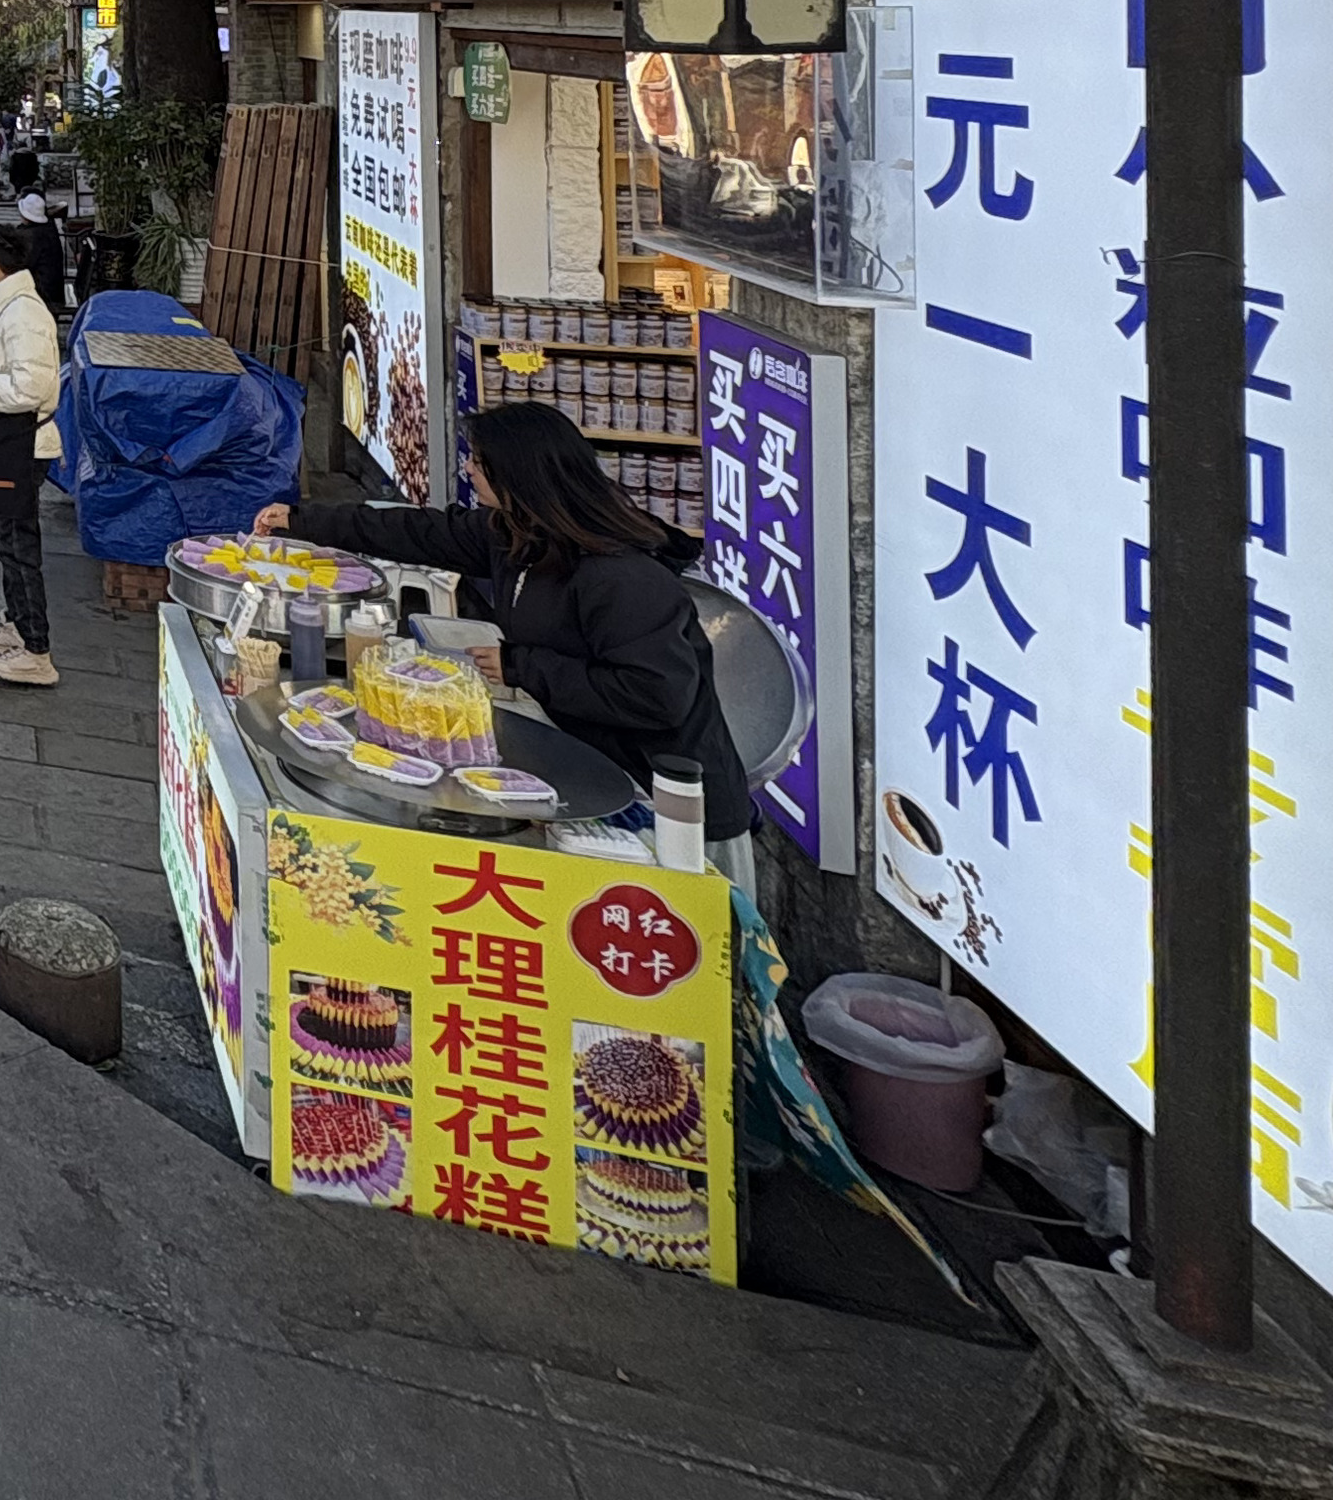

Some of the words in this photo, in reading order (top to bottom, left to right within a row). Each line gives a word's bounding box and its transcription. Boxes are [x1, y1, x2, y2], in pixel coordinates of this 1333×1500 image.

[349, 29, 404, 86] 现磨咖啡
[350, 87, 406, 155] 免费试喝
[351, 149, 407, 223] 全国包邮
[708, 349, 750, 604] 买四送
[600, 903, 675, 938] 网红
[599, 944, 675, 979] 打卡
[429, 851, 552, 1247] 大理桂花糕
